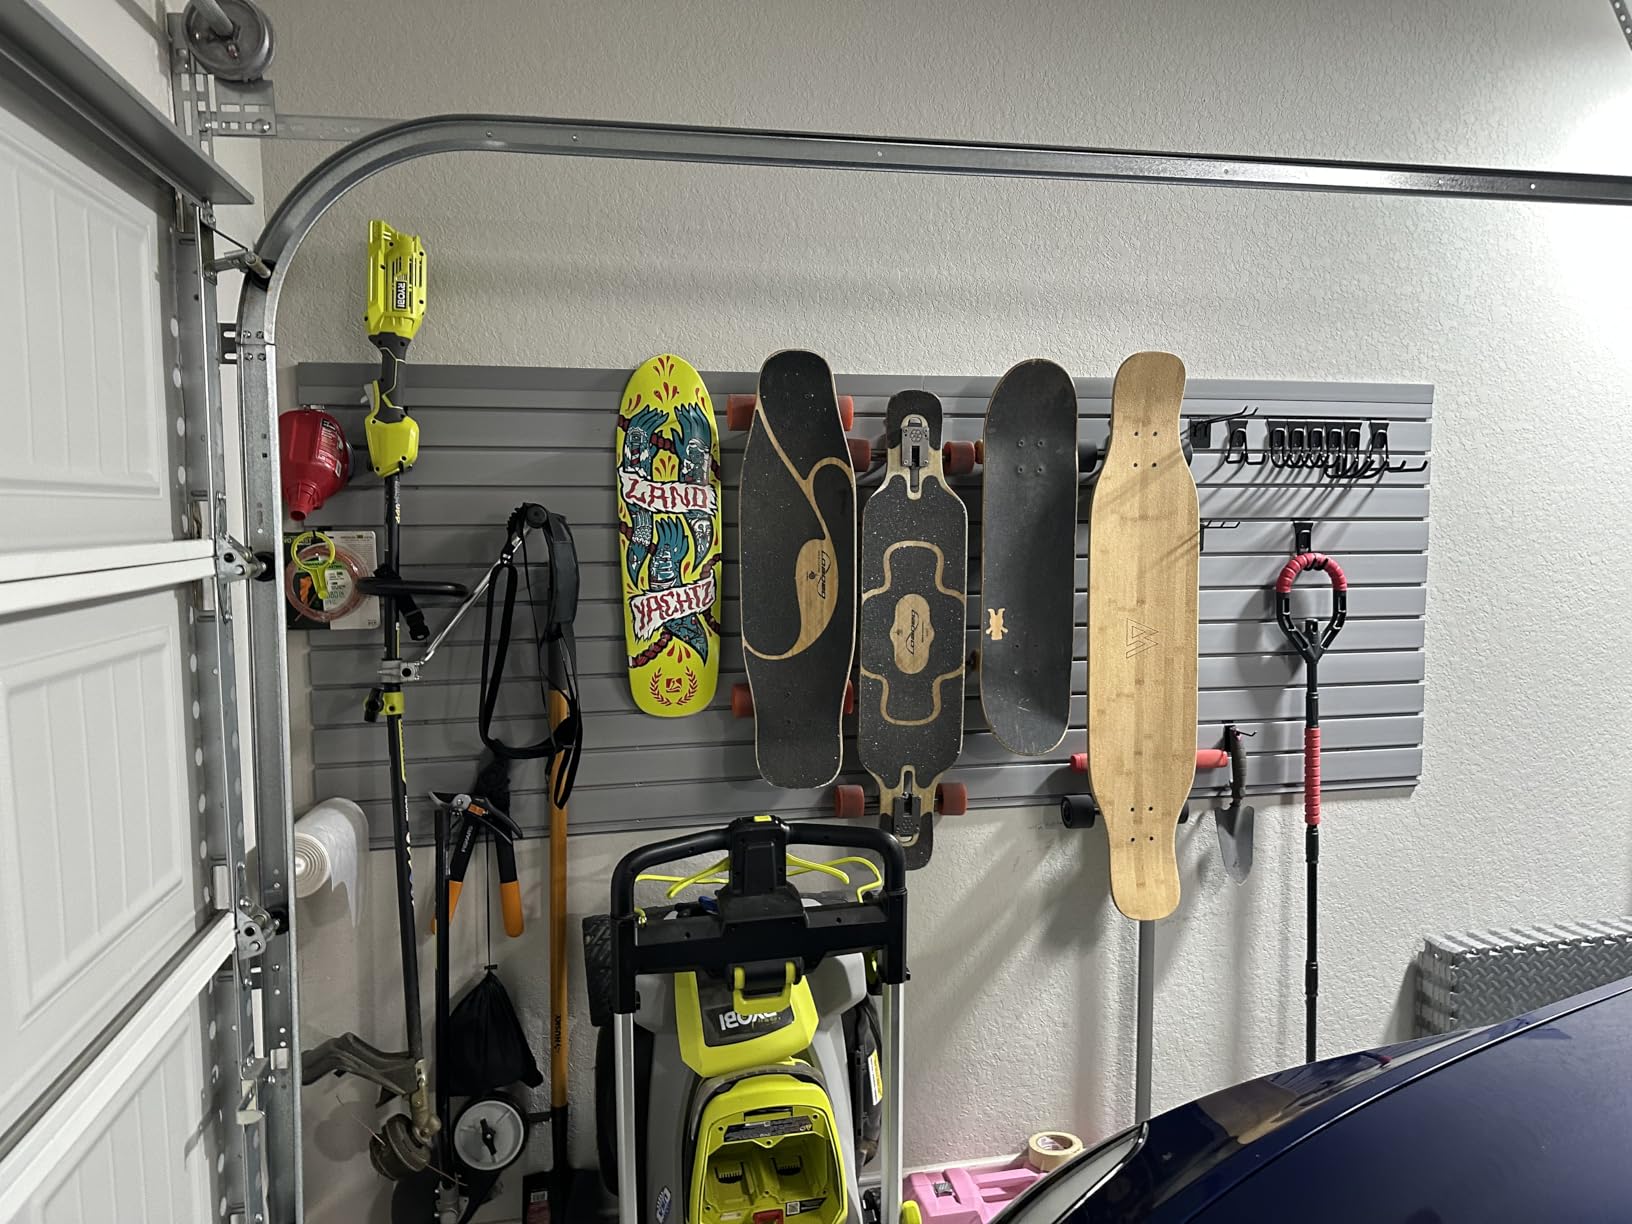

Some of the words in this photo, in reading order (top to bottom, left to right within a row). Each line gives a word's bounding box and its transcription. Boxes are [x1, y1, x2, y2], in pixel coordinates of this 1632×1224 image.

[397, 282, 406, 308] RYOBI
[625, 478, 707, 508] LAND
[634, 580, 714, 630] YACHTZ
[718, 1010, 777, 1031] YOBI
